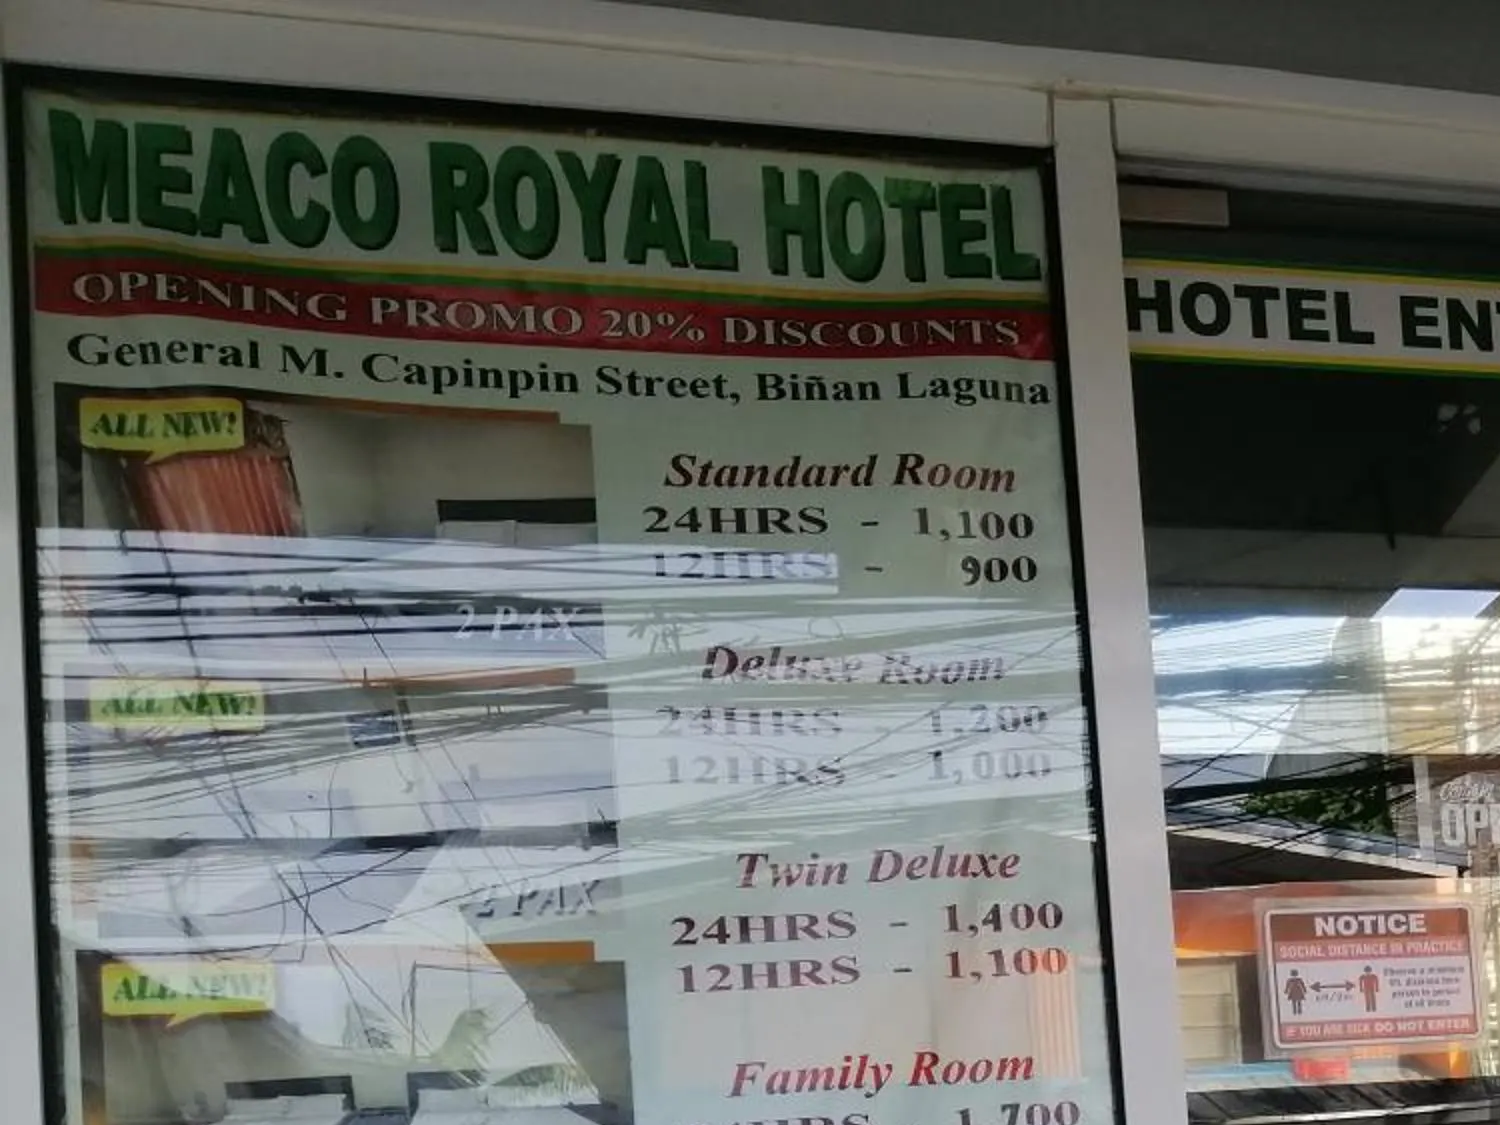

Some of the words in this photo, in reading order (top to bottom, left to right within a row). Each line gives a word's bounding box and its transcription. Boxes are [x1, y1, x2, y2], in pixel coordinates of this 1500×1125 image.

[48, 108, 400, 250] MEACO
[428, 141, 739, 271] ROYAL
[760, 165, 1041, 282] HOTEL
[73, 271, 347, 322] OPENING
[371, 296, 583, 337] PROMO
[601, 308, 706, 343] 20%
[724, 316, 1020, 348] DISCOUNTS
[1125, 278, 1374, 345] HOTEL
[67, 333, 260, 370] General
[279, 346, 344, 380] M.
[361, 351, 579, 398] Capinpin
[596, 365, 741, 404] Street,
[756, 371, 881, 403] Biñan
[897, 371, 1051, 406] Laguna
[89, 412, 156, 438] ALL
[161, 410, 237, 438] NEW!
[664, 453, 878, 488] Standard
[893, 453, 1016, 493] Room
[642, 506, 829, 534] 24HRS
[914, 507, 1035, 542] 1,100
[654, 552, 834, 579] 12HRS
[961, 555, 1038, 586] 900
[456, 604, 475, 641] 2
[490, 604, 582, 642] PAX
[701, 645, 863, 684] Deluxe
[880, 654, 1007, 685] Room
[102, 697, 164, 715] ALL
[173, 692, 256, 716] NEW!
[658, 705, 843, 737] 24HRS
[928, 705, 1048, 737] 1,200
[664, 756, 847, 786] 12HRS
[927, 749, 1051, 785] 1,000
[735, 852, 848, 889] Twin
[867, 845, 1021, 884] Deluxe
[510, 879, 600, 917] PAX
[671, 909, 857, 946] 24HRS
[942, 901, 1063, 938] 1,400
[1314, 912, 1426, 936] NOTICE
[1279, 945, 1326, 958] SOCIAL
[1328, 943, 1388, 956] DISTANCE
[113, 976, 178, 1002] ALL
[677, 955, 861, 993] 12HRS
[946, 947, 1069, 982] 1,100
[1300, 1025, 1321, 1036] YOU
[1374, 1022, 1393, 1032] DO
[1398, 1021, 1424, 1031] NOT
[1428, 1018, 1469, 1030] ENTER
[726, 1054, 893, 1099] Family
[908, 1050, 1034, 1088] Room
